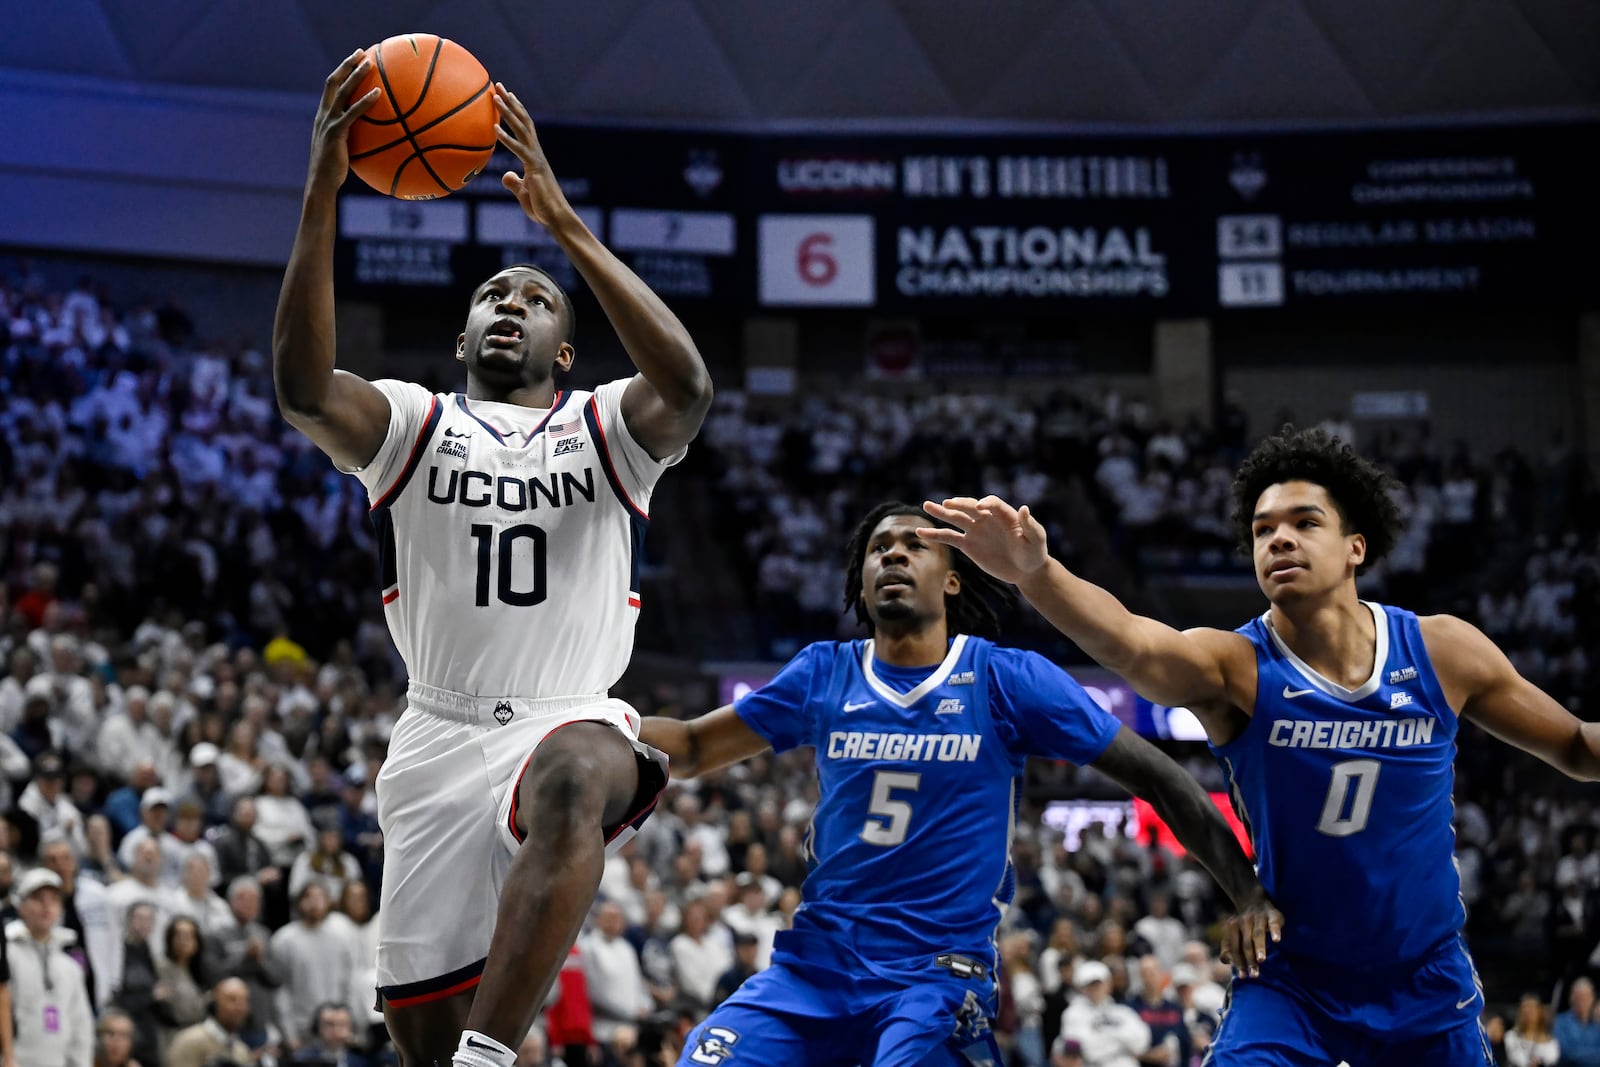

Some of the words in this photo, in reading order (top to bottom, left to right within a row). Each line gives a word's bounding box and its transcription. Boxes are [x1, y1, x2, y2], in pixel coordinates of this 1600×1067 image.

[777, 159, 896, 190] UCONN
[796, 232, 838, 288] 6
[897, 226, 1166, 267] NATIONAL
[896, 267, 1170, 298] CHAMPIONSHIPS
[436, 446, 467, 460] CHANGE
[441, 439, 453, 448] BE
[454, 441, 466, 453] THE
[554, 442, 585, 454] EAST
[556, 436, 579, 447] BIG
[427, 465, 596, 512] UCONN
[470, 523, 547, 607] 10
[827, 731, 982, 762] CREIGHTON
[1268, 717, 1436, 749] CREIGHTON
[859, 770, 922, 846] 5
[1314, 758, 1382, 838] 0
